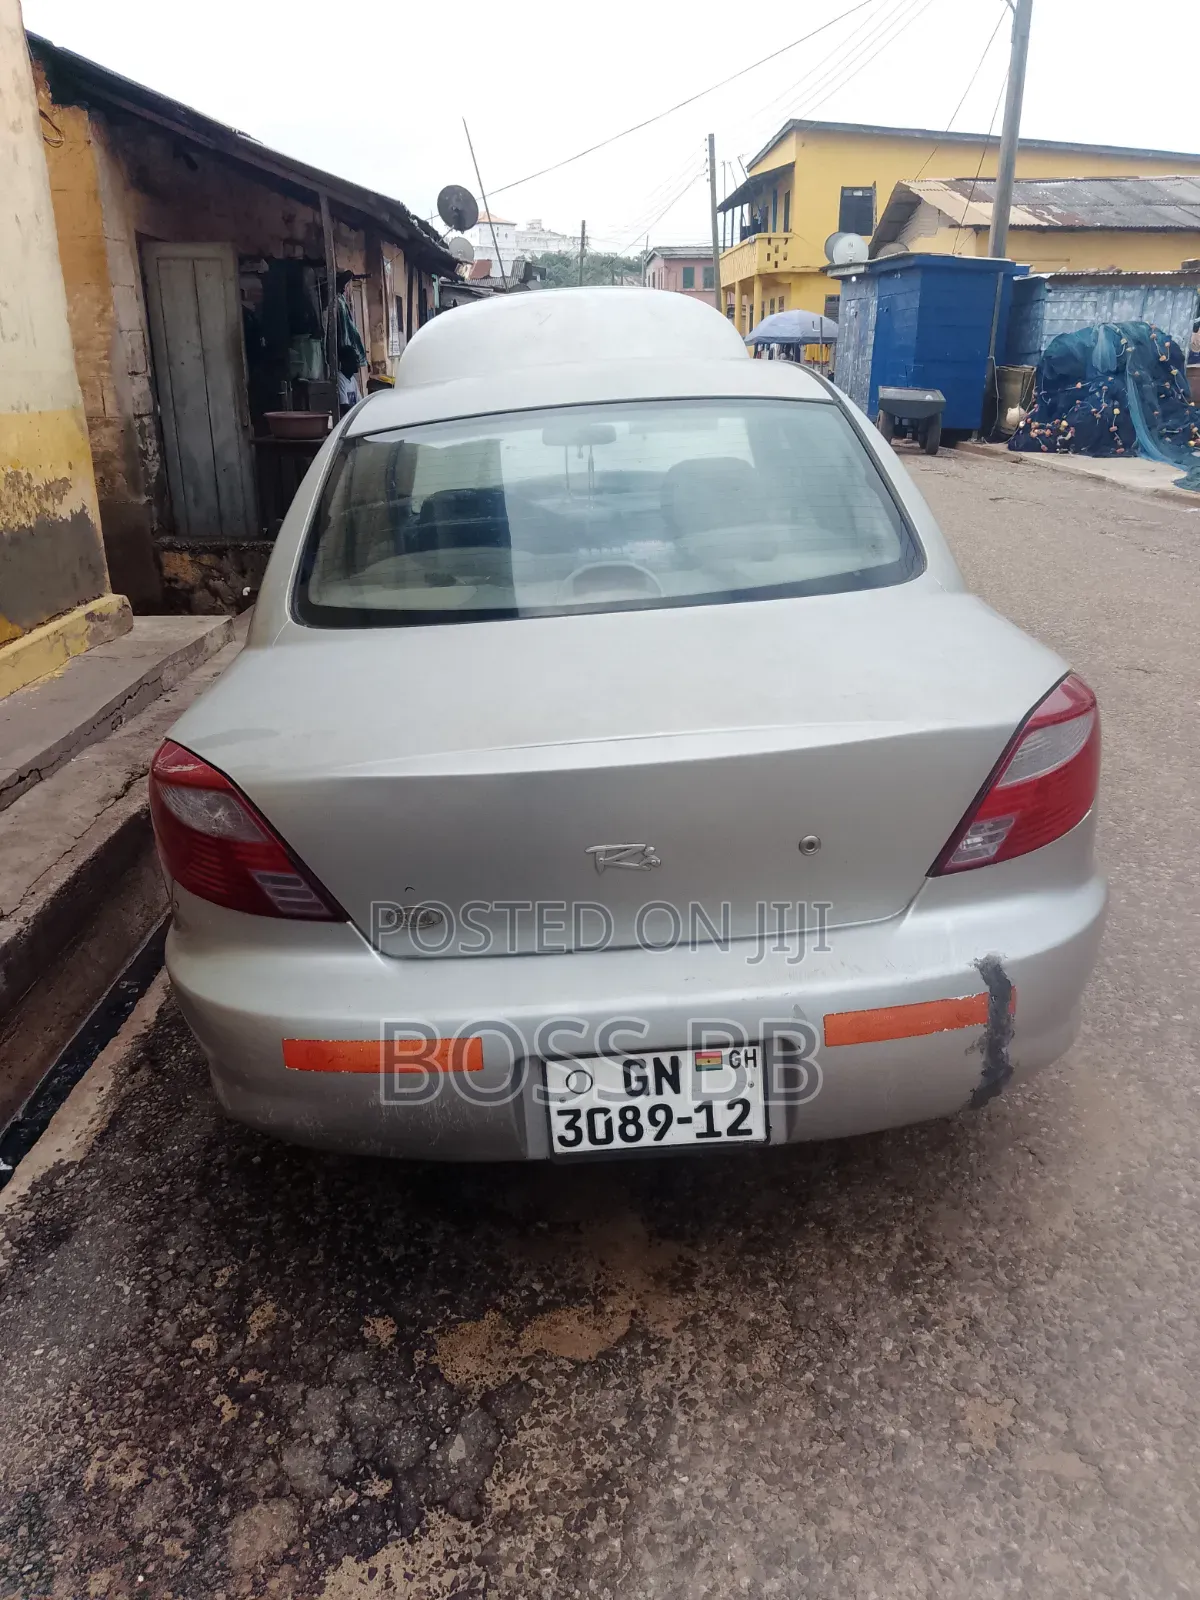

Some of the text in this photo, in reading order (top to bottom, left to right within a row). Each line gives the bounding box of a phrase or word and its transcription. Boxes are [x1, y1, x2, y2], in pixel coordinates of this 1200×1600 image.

[622, 1048, 757, 1097] GN GH
[556, 1098, 753, 1148] 3089-12
